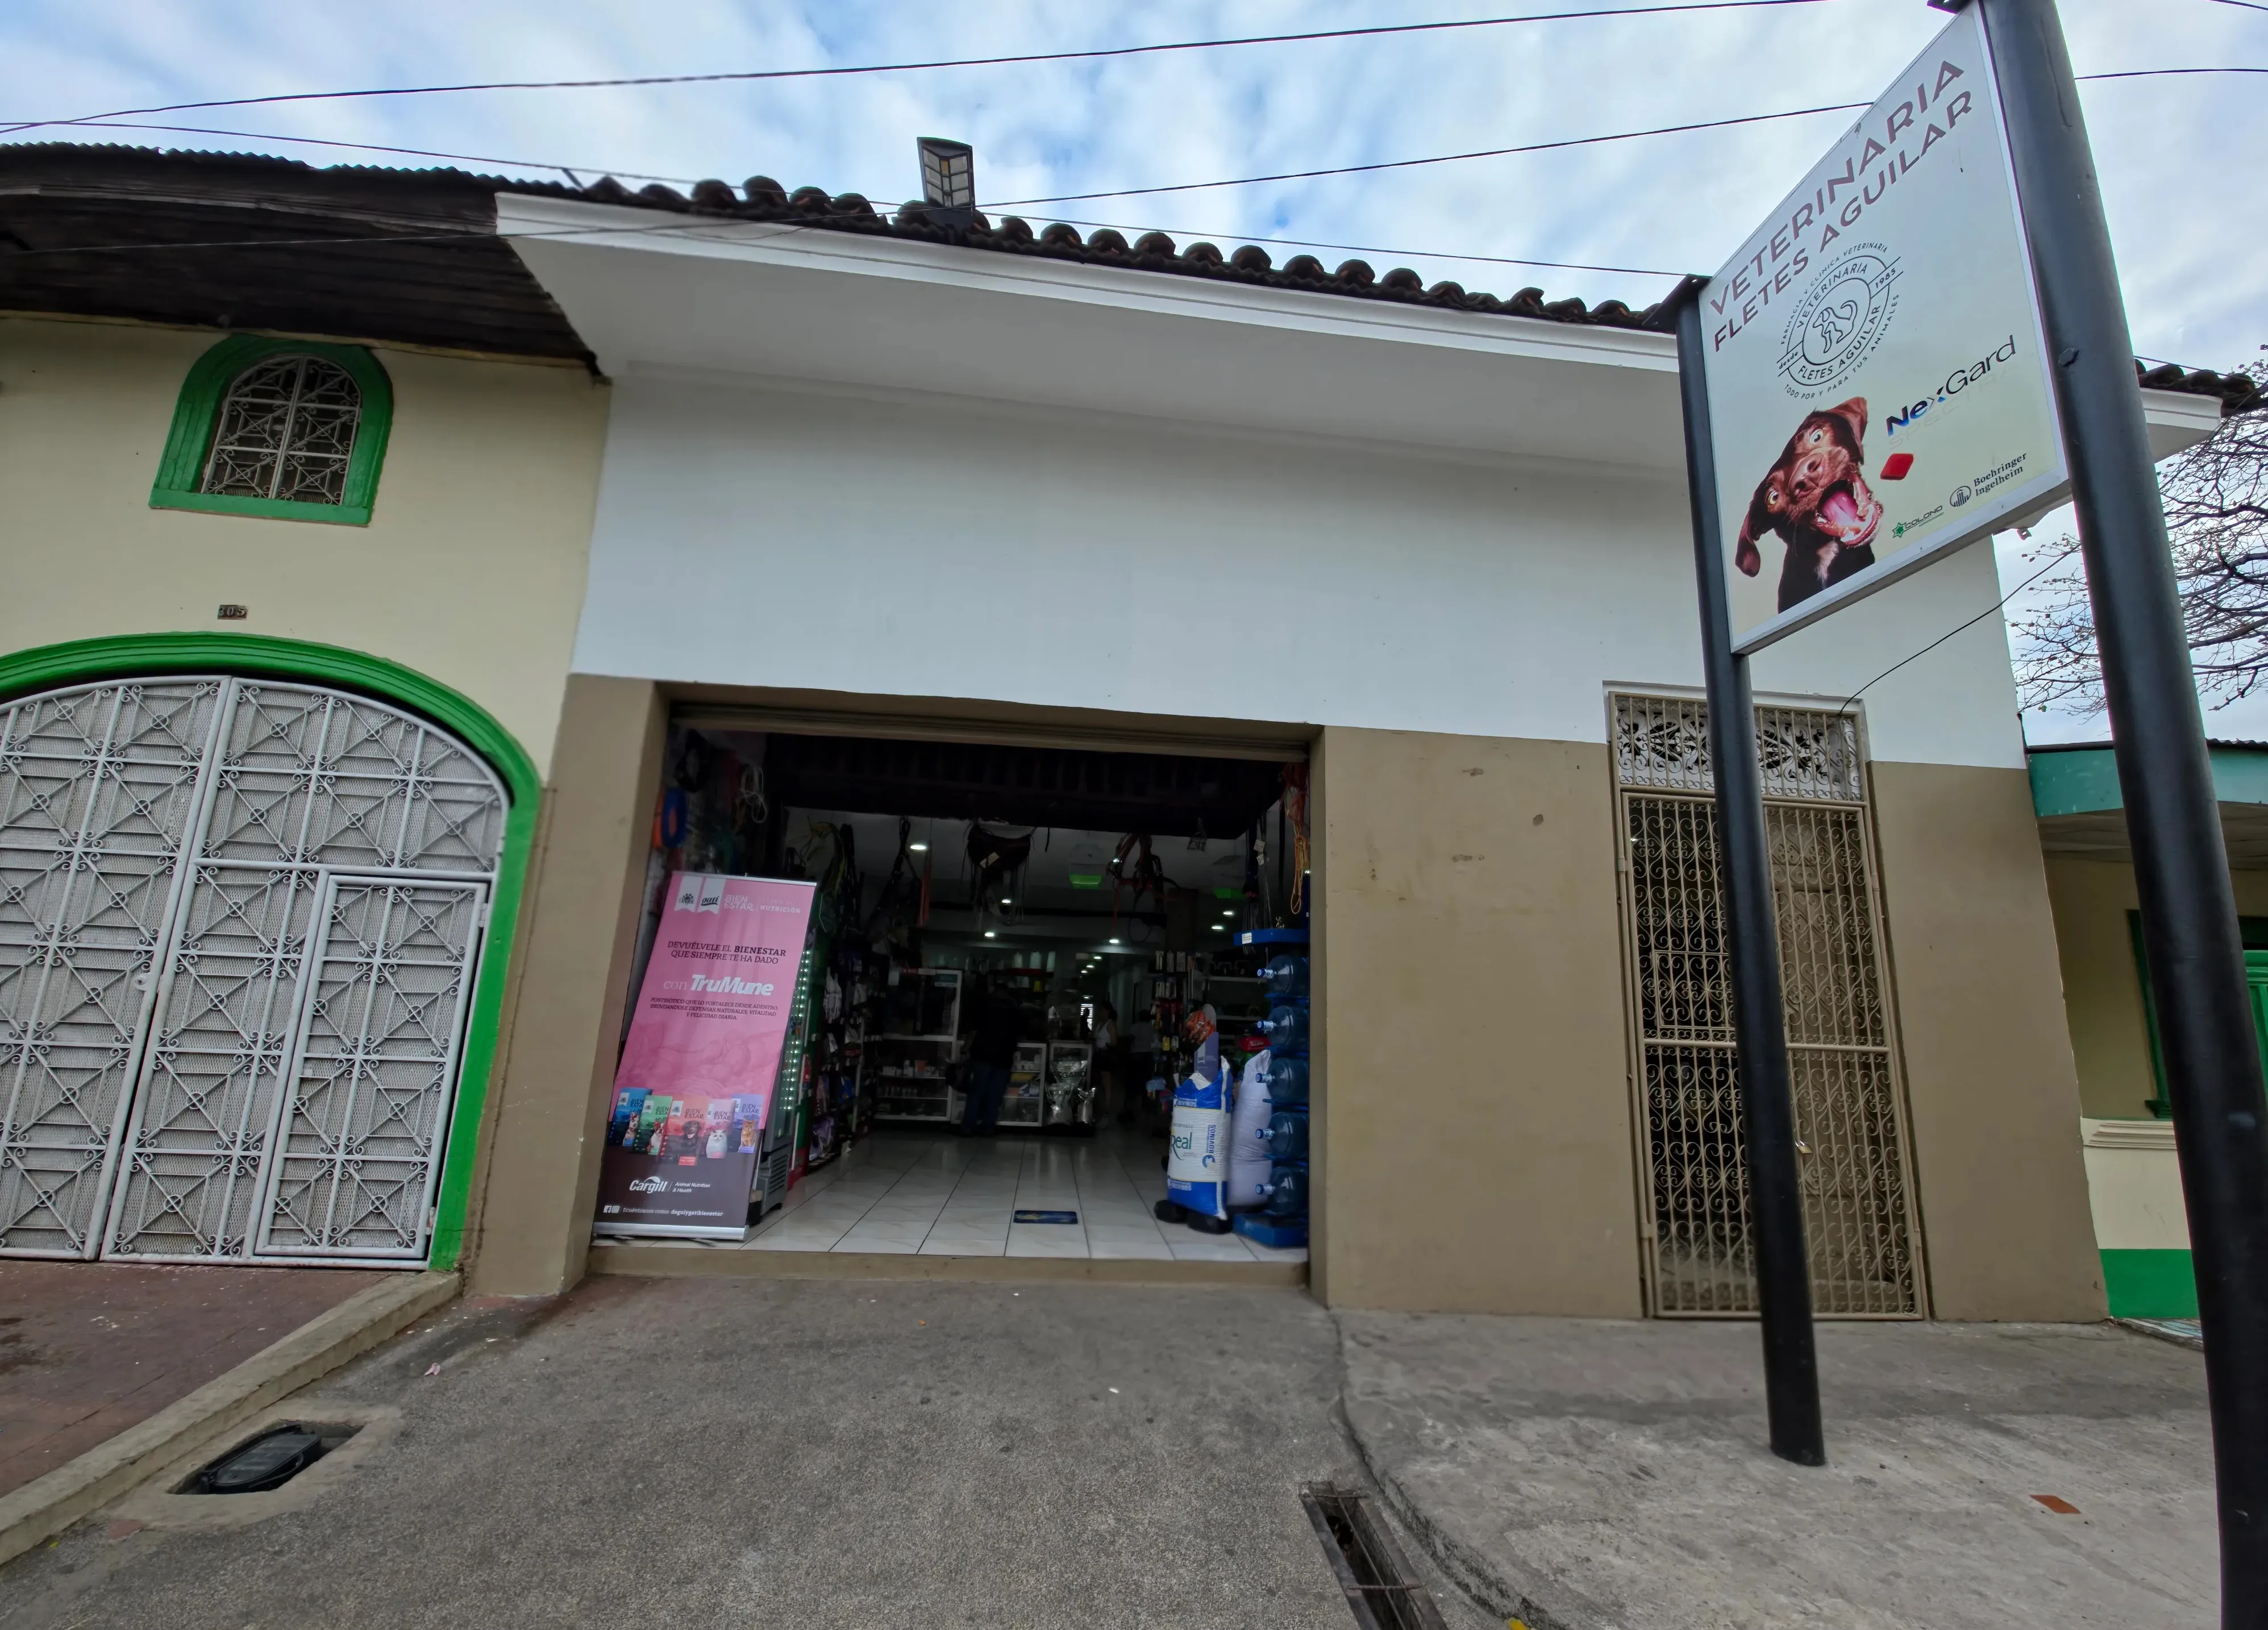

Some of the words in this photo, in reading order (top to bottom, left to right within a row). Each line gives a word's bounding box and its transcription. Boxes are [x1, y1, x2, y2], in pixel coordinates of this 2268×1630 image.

[1710, 60, 1964, 315] VETERINARIA
[1714, 247, 1809, 352] FLETES
[1820, 91, 1972, 253] AGUILAR
[1875, 268, 1896, 288] 1985
[1781, 299, 1803, 345] FARMACIA
[1843, 243, 1888, 256] VETERINARIA
[1797, 262, 1868, 328] VETERINARIA
[1784, 384, 1799, 398] TODO
[1828, 376, 1848, 393] PARA
[1852, 356, 1867, 373] TUS
[1871, 295, 1899, 352] ANIMALES
[1798, 365, 1833, 380] FLETES
[1838, 305, 1881, 369] AGUILAR
[1779, 352, 1798, 369] desde
[1886, 335, 2016, 436] NexGard
[1974, 453, 2027, 487] Boehringer
[1975, 466, 2023, 497] Ingelheim
[1905, 505, 1942, 530] COLONO
[724, 902, 754, 911] ESTAR
[725, 894, 747, 903] BIEN
[667, 941, 721, 951] DEVUÉLVELE
[734, 946, 786, 957] BIENESTAR
[671, 950, 689, 958] QUE
[690, 952, 727, 961] SIEMPRE
[754, 956, 779, 964] DADO
[663, 981, 687, 990] con
[690, 974, 774, 996] TruMune
[1170, 1132, 1192, 1161] Real
[629, 1177, 668, 1194] Cargill
